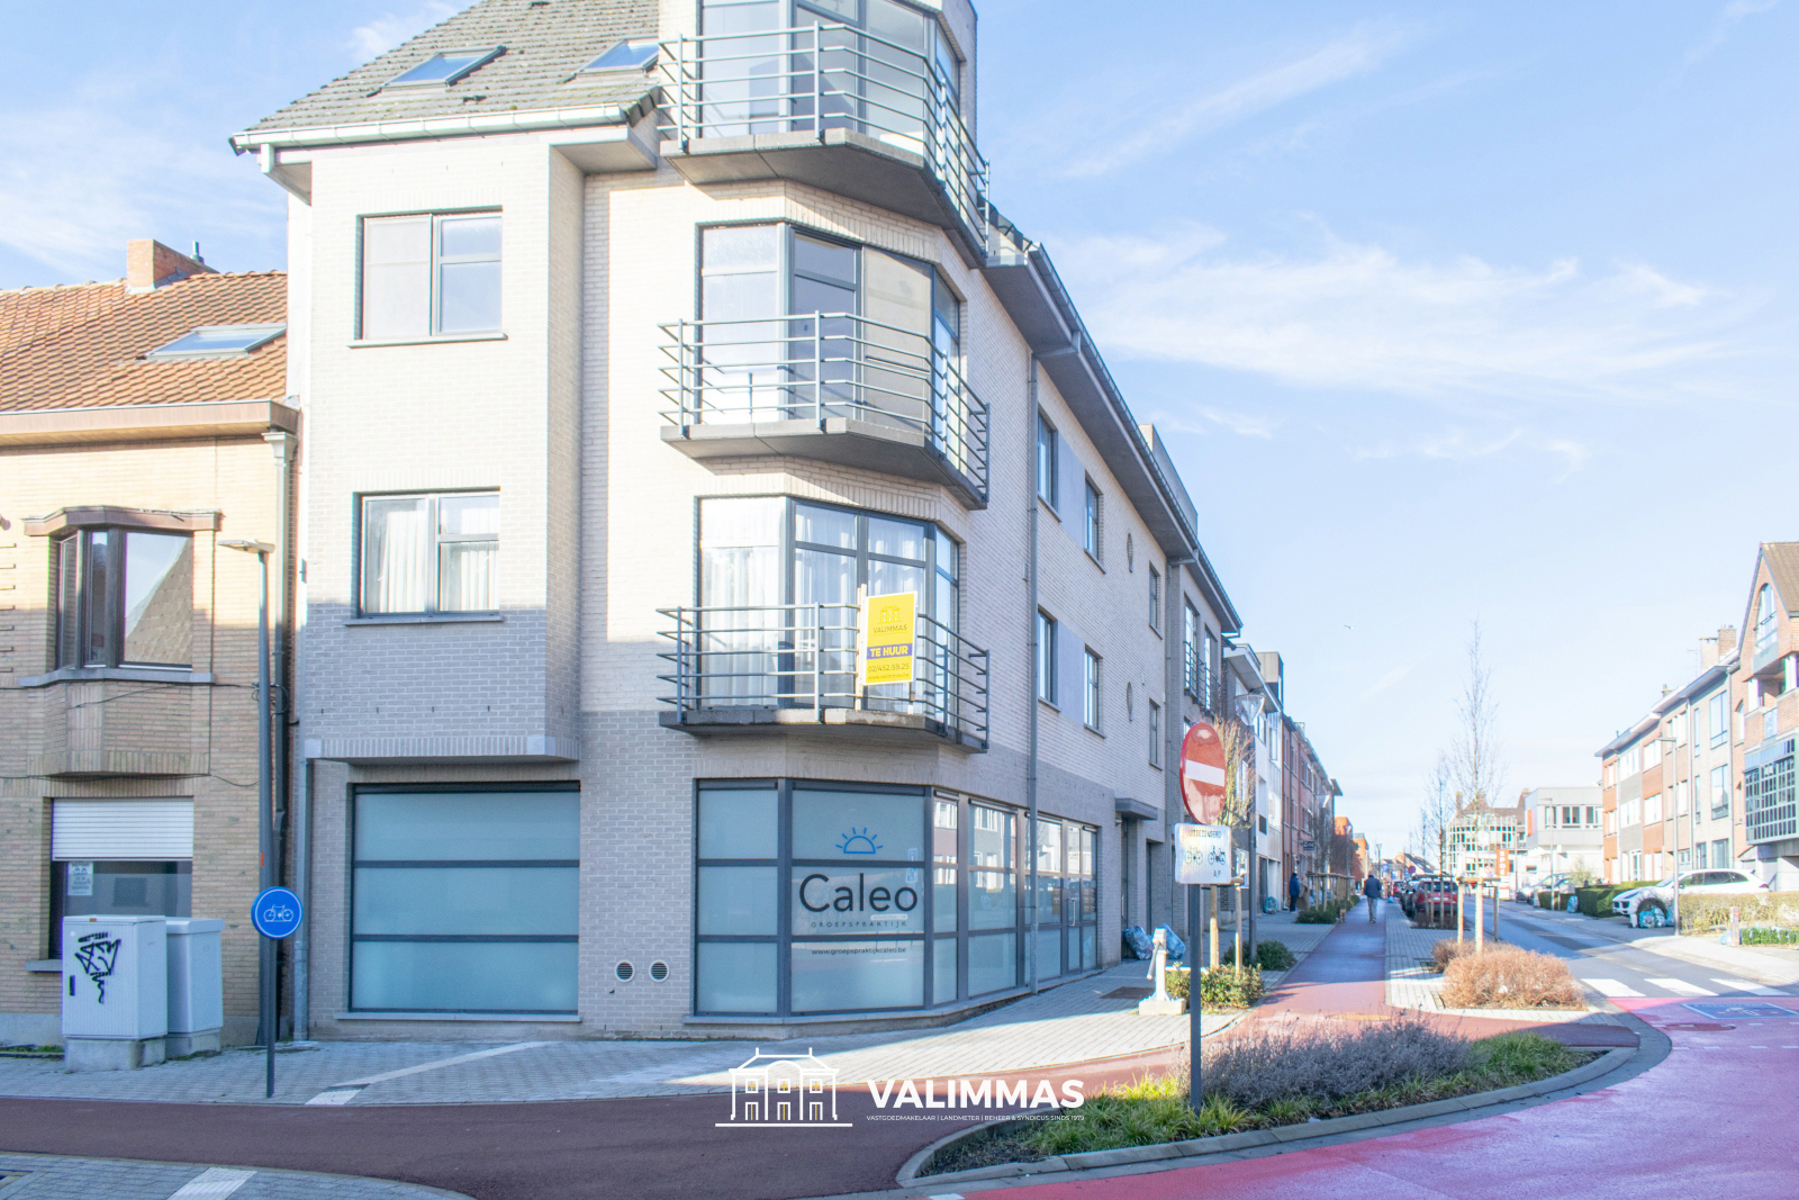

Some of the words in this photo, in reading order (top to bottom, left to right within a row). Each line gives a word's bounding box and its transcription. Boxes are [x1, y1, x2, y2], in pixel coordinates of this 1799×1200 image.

[873, 625, 907, 633] VALIMMAS
[870, 648, 881, 657] TE
[882, 646, 908, 656] HUUR
[799, 873, 918, 912] Caleo
[811, 947, 906, 955] www.groepspraktijkcaleo.be
